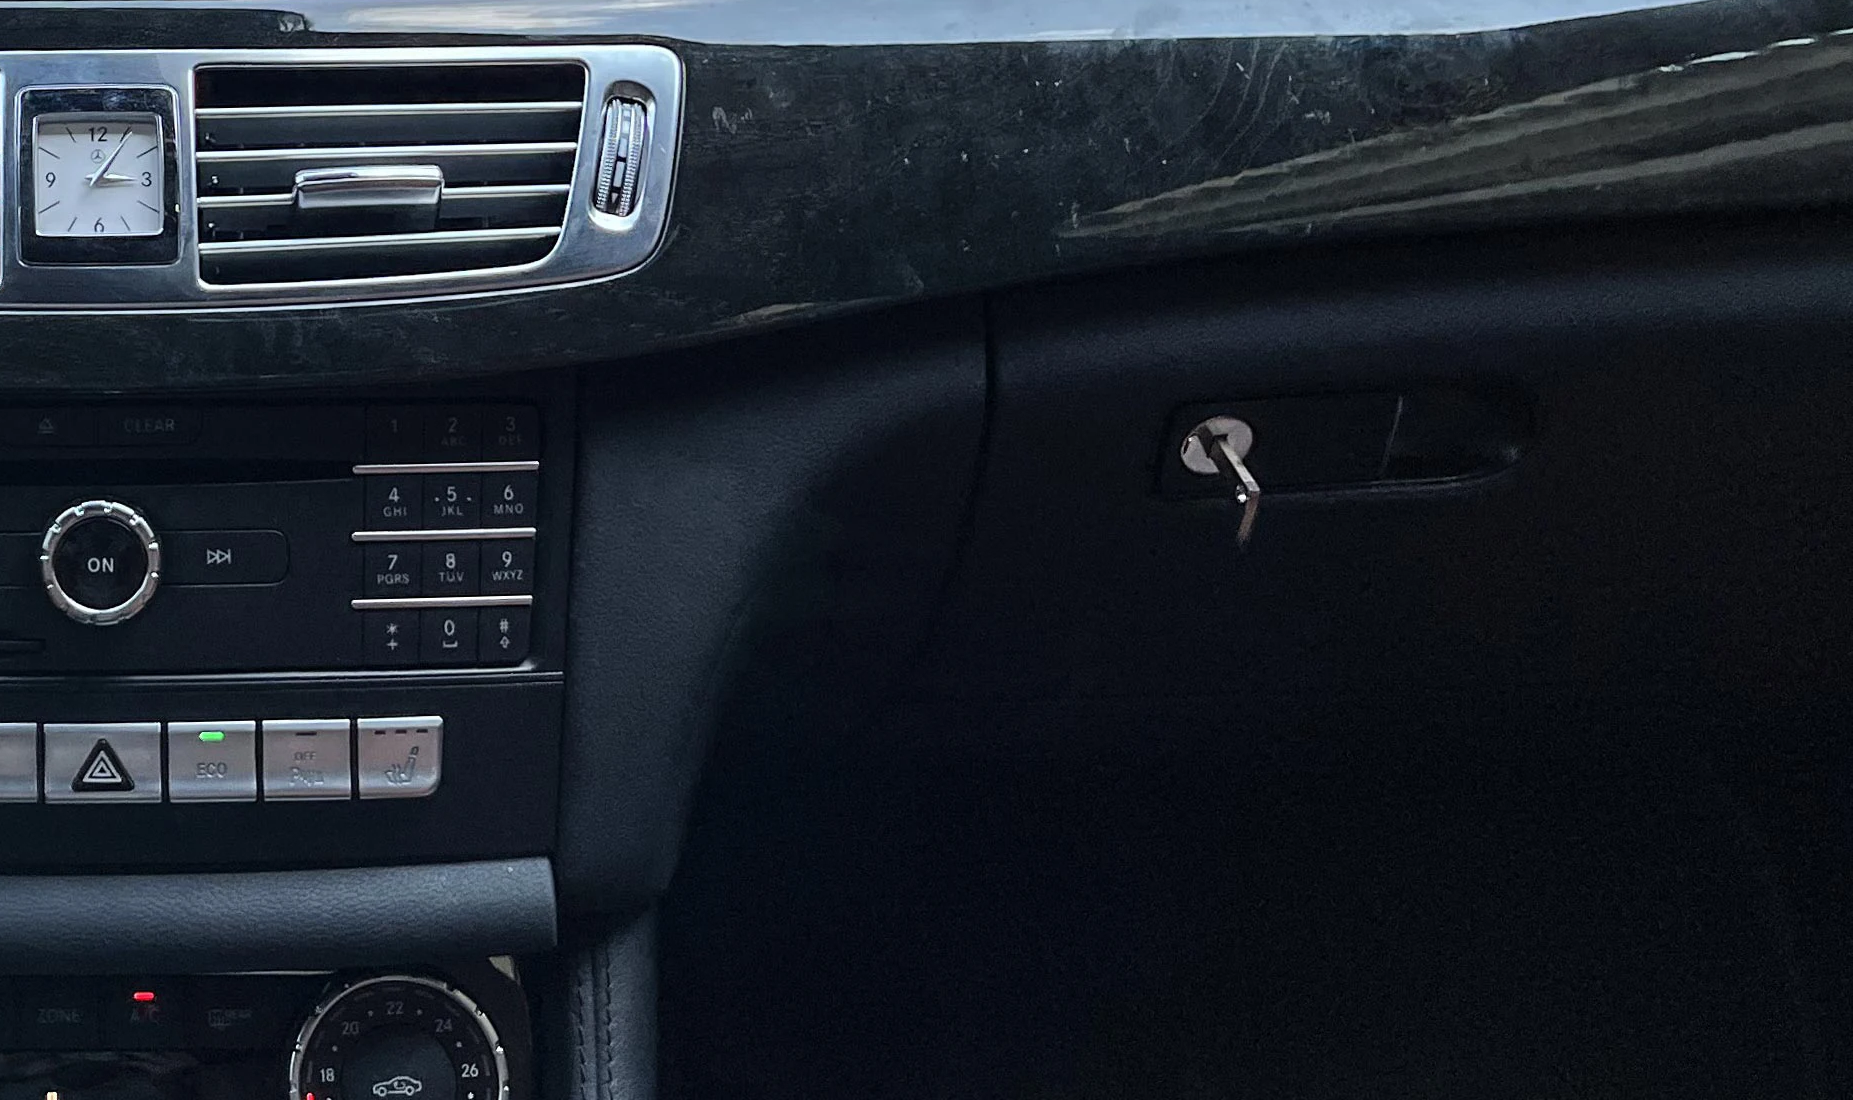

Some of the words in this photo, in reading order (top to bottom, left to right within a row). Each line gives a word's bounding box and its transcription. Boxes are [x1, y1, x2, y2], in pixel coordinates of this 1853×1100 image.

[88, 126, 108, 142] 12
[45, 171, 57, 188] 9
[141, 171, 153, 187] 3
[93, 217, 106, 233] 6
[388, 487, 400, 502] 4
[447, 486, 457, 502] 5
[503, 484, 514, 500] 6
[383, 506, 408, 517] GHI
[441, 506, 464, 517] JKL
[493, 503, 524, 515] MNO
[88, 557, 114, 573] ON
[387, 554, 398, 570] 7
[445, 553, 456, 569] 8
[502, 550, 513, 568] 9
[439, 571, 465, 583] TUV
[492, 569, 524, 581] WXYZ
[443, 619, 455, 636] 0
[197, 762, 228, 779] ECO
[385, 1001, 404, 1016] 22
[342, 1020, 360, 1035] 20
[435, 1019, 453, 1034] 24
[320, 1067, 335, 1083] 18
[461, 1063, 479, 1079] 26
